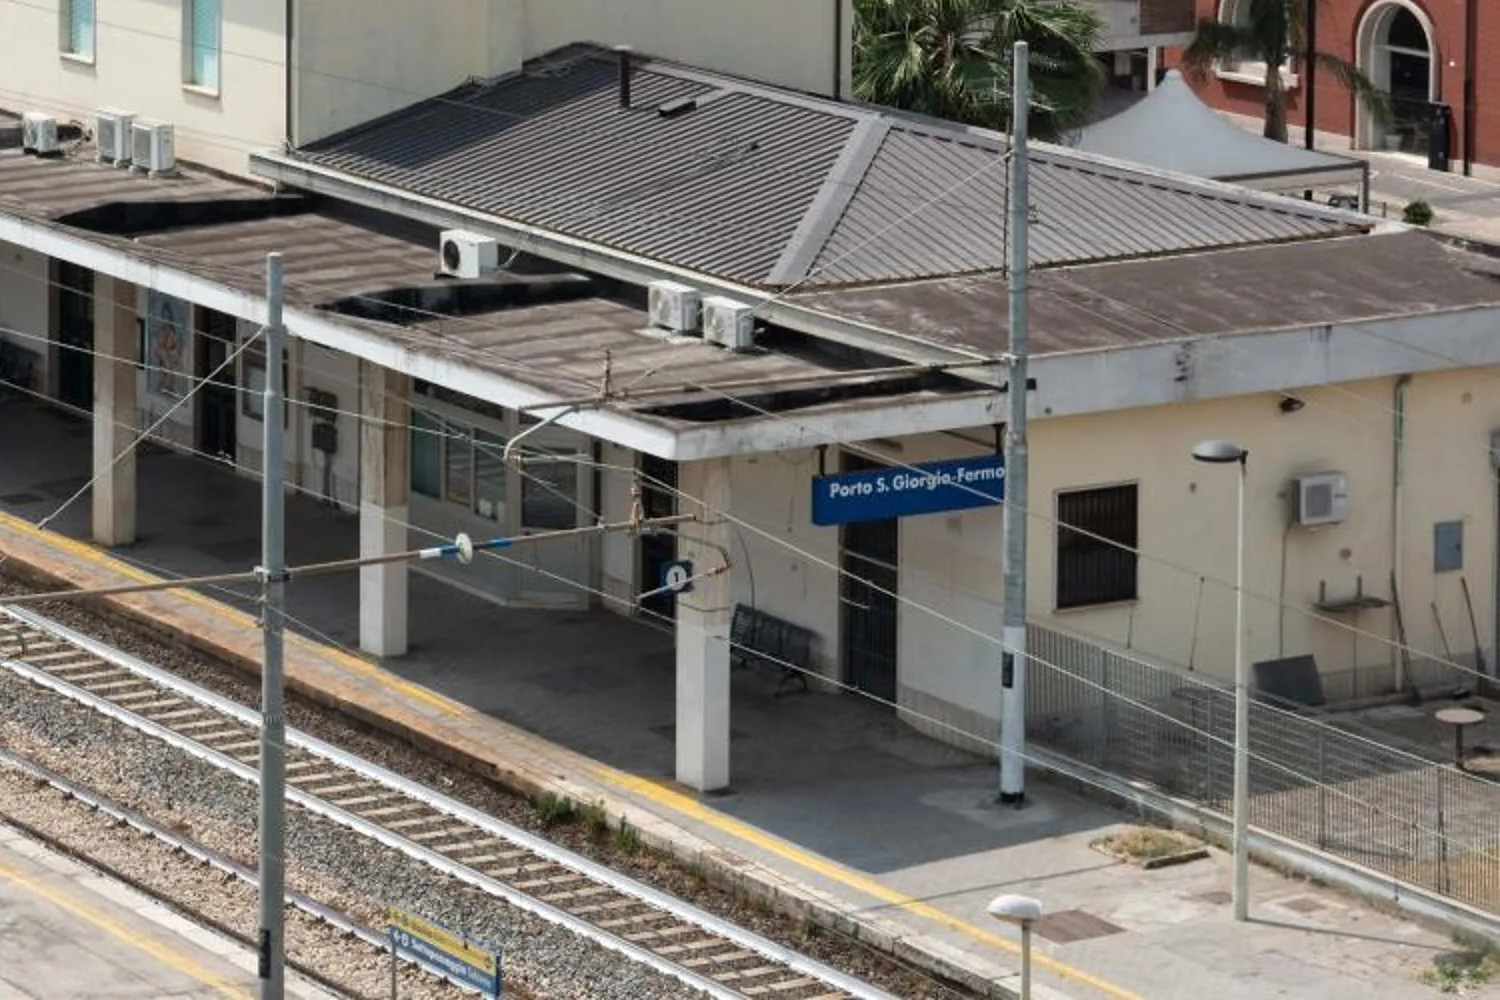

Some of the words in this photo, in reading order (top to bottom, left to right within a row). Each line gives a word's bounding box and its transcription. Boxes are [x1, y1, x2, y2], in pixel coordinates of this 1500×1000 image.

[829, 482, 873, 498] Porto
[876, 477, 889, 493] S.
[893, 466, 1005, 490] Giorgio-Fermo
